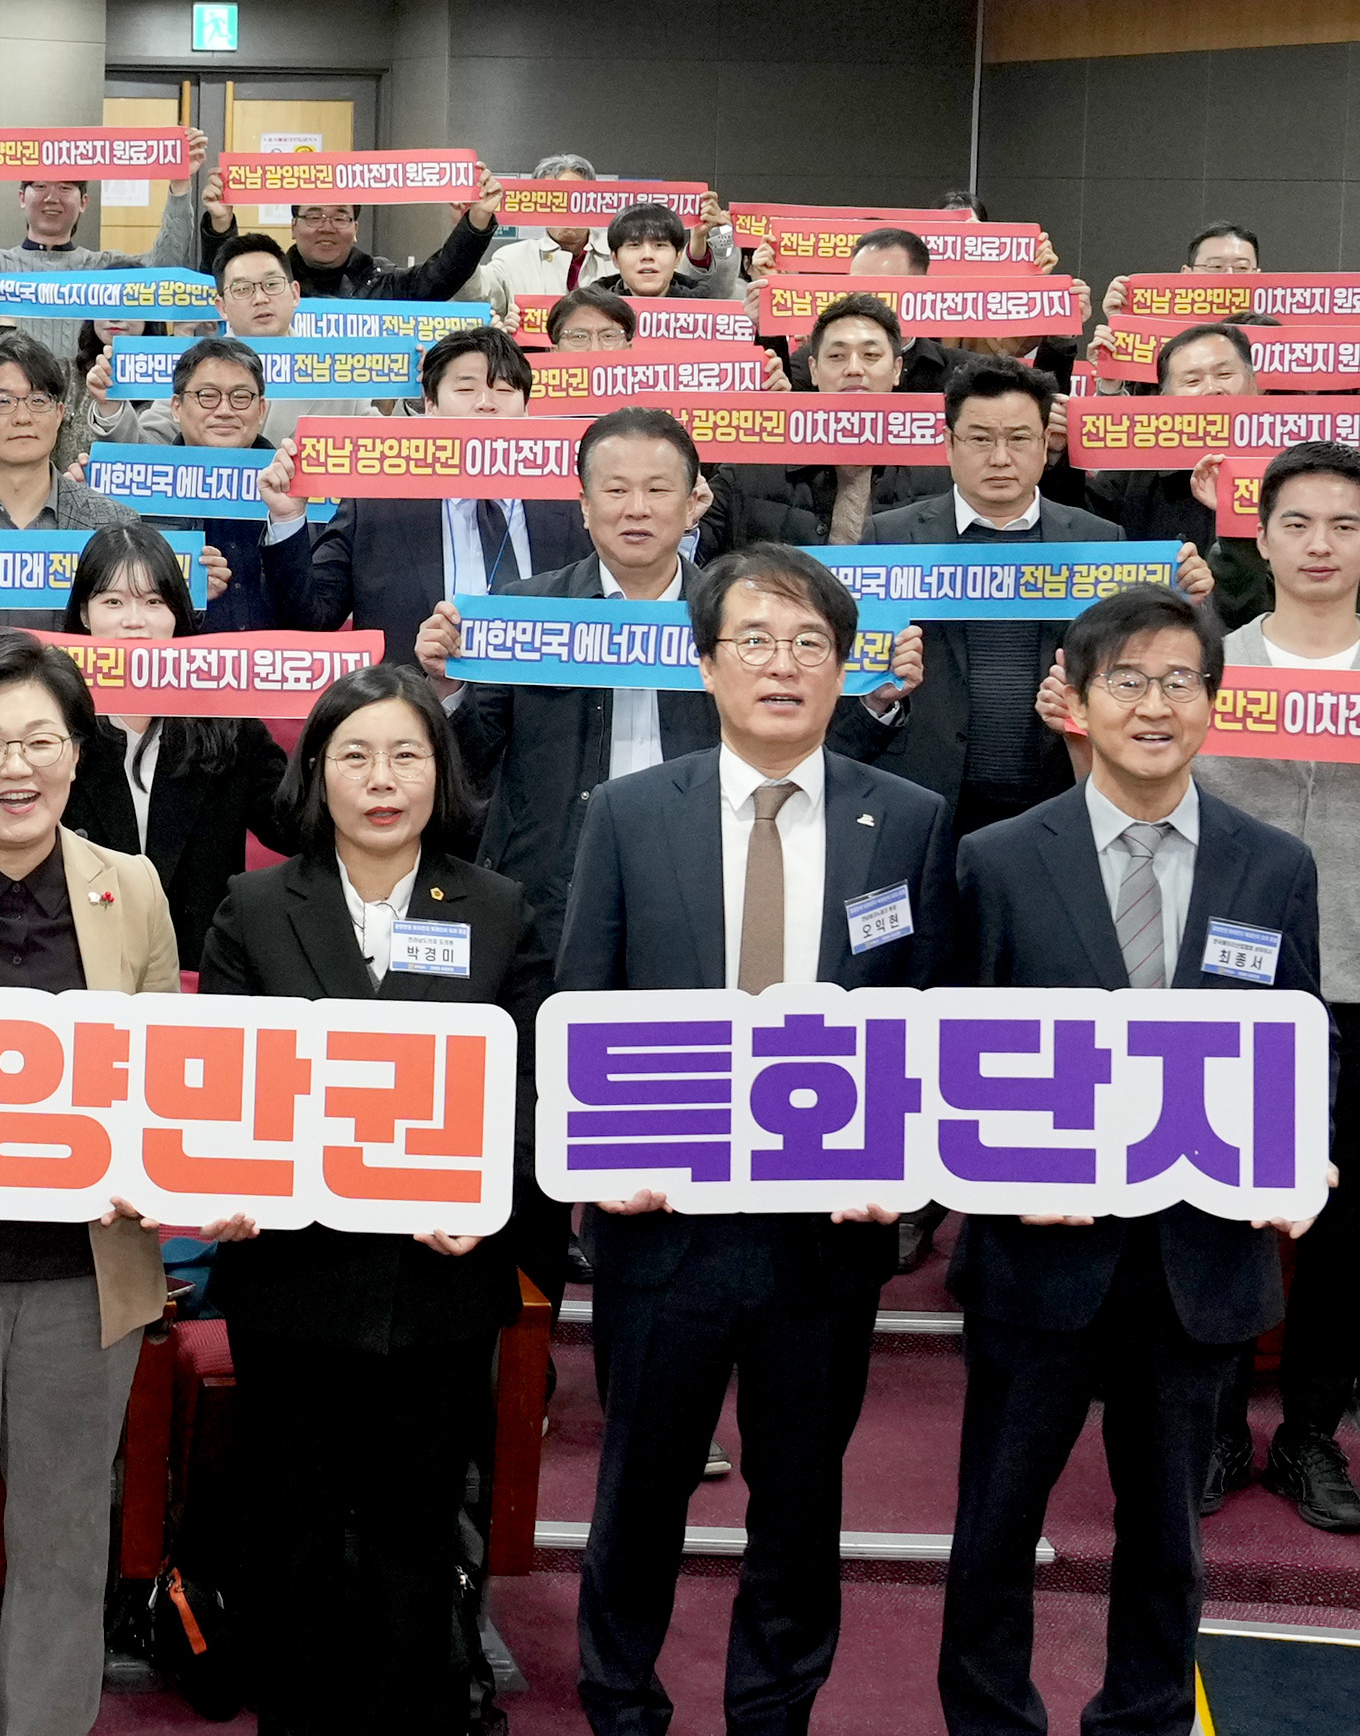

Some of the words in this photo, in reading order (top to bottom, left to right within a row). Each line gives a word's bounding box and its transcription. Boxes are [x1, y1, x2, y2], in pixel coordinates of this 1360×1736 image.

[41, 141, 110, 166] 이차전지
[112, 139, 182, 165] 원료기지
[228, 165, 264, 190] 전남
[265, 164, 334, 190] 광양만권
[335, 163, 404, 189] 이차전지
[405, 162, 474, 188] 원료기지
[504, 190, 569, 215] 광양만권
[736, 214, 768, 237] 전남
[780, 232, 816, 257] 전남
[964, 236, 1036, 263] 원료기지
[37, 282, 87, 306] 에너지
[122, 282, 156, 306] 전남
[771, 288, 813, 317] 전남
[901, 291, 983, 322] 이차전지
[986, 290, 1071, 318] 원료기지
[1132, 288, 1172, 313] 전남
[1174, 287, 1252, 315] 광양만권
[1254, 287, 1331, 315] 이차전지
[639, 310, 714, 340] 이차전지
[294, 353, 332, 383] 전남
[334, 353, 409, 382] 광양만권
[1113, 331, 1158, 364] 전남
[1251, 343, 1335, 374] 이차전지
[592, 365, 675, 396] 이차전지
[678, 362, 763, 392] 원료기지
[691, 409, 786, 442] 광양만권
[789, 411, 883, 444] 이차전지
[1081, 413, 1130, 447] 전남
[1132, 413, 1231, 447] 광양만권
[1233, 413, 1334, 448] 이차전지
[300, 436, 353, 474] 전남
[355, 435, 461, 476] 광양만권
[465, 438, 569, 476] 이차전지
[91, 461, 175, 494] 대한민국
[176, 463, 239, 499] 에너지
[890, 565, 962, 600] 에너지
[967, 565, 1016, 599] 미래
[1019, 565, 1069, 598] 전남
[460, 619, 569, 662] 대한민국
[572, 624, 659, 664] 에너지
[131, 648, 248, 690] 이차전지
[566, 1013, 1297, 1190] 특화단지
